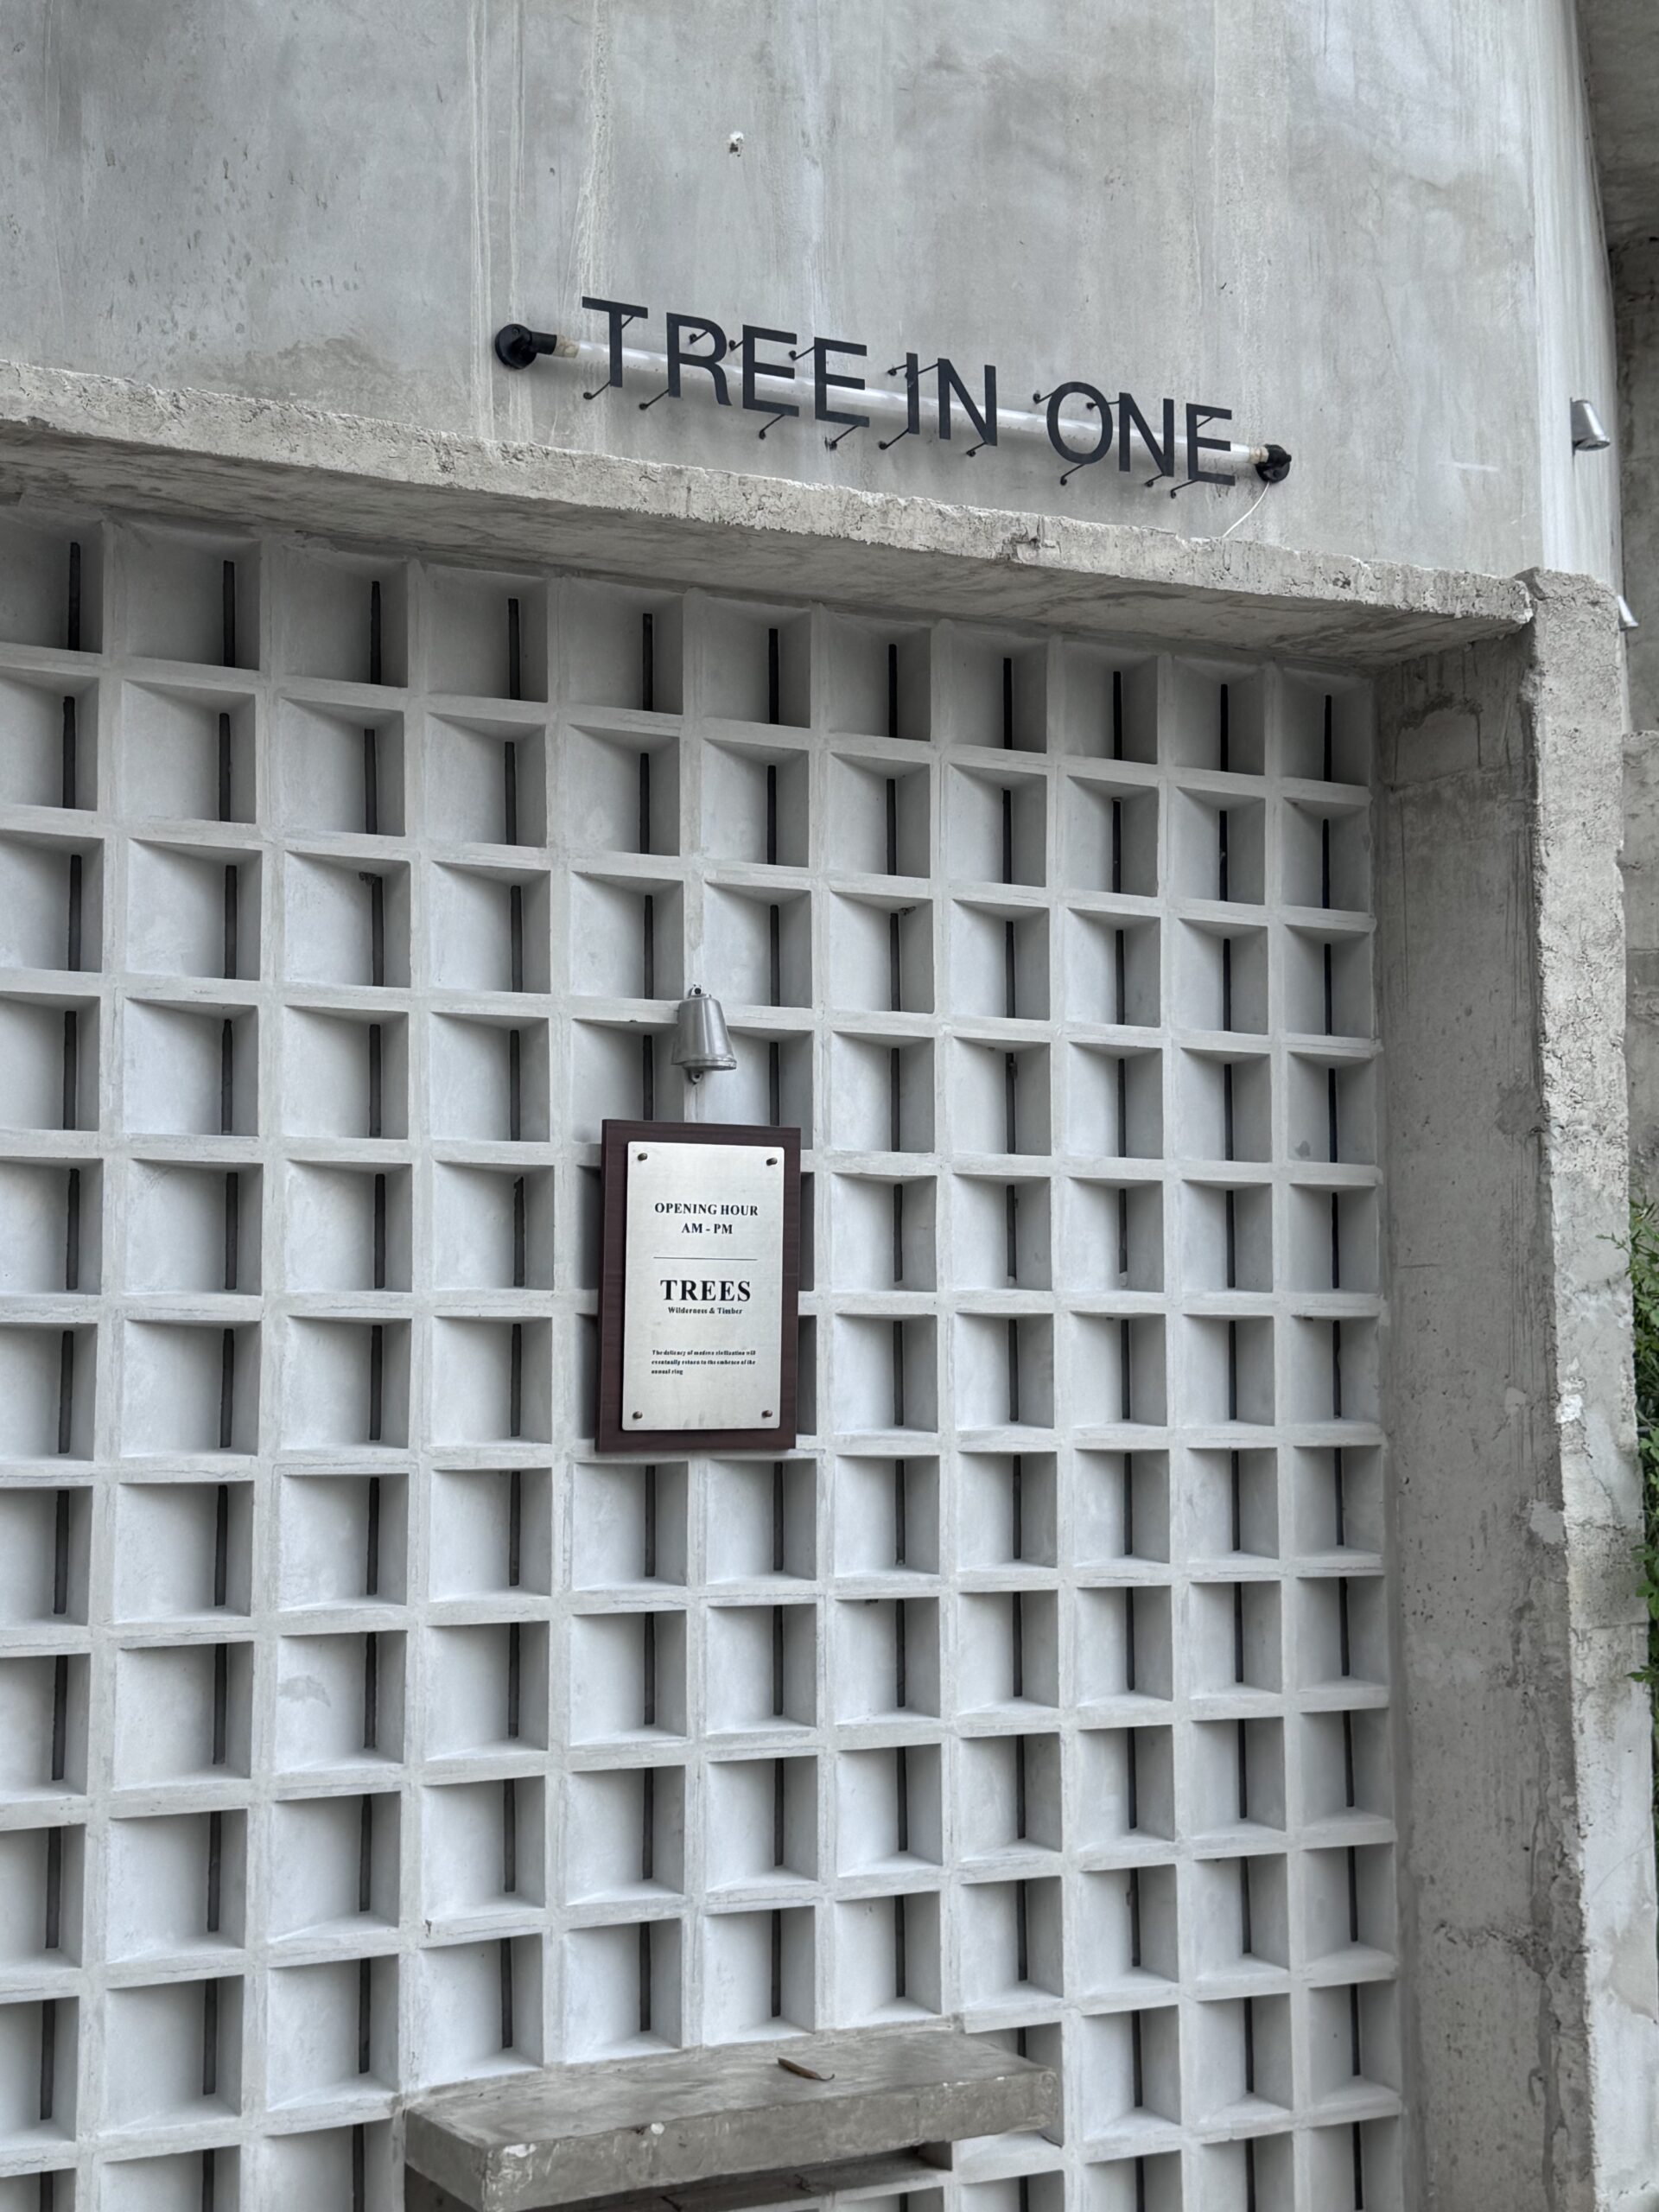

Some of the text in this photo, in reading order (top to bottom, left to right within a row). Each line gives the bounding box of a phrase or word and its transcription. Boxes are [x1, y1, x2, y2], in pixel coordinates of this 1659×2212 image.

[582, 296, 1236, 486] TREE IN ONE
[654, 1202, 759, 1216] OPENING HOUR
[682, 1223, 702, 1234] AM
[714, 1224, 733, 1235] PM
[659, 1279, 751, 1302] TREES
[717, 1306, 743, 1315] Timber
